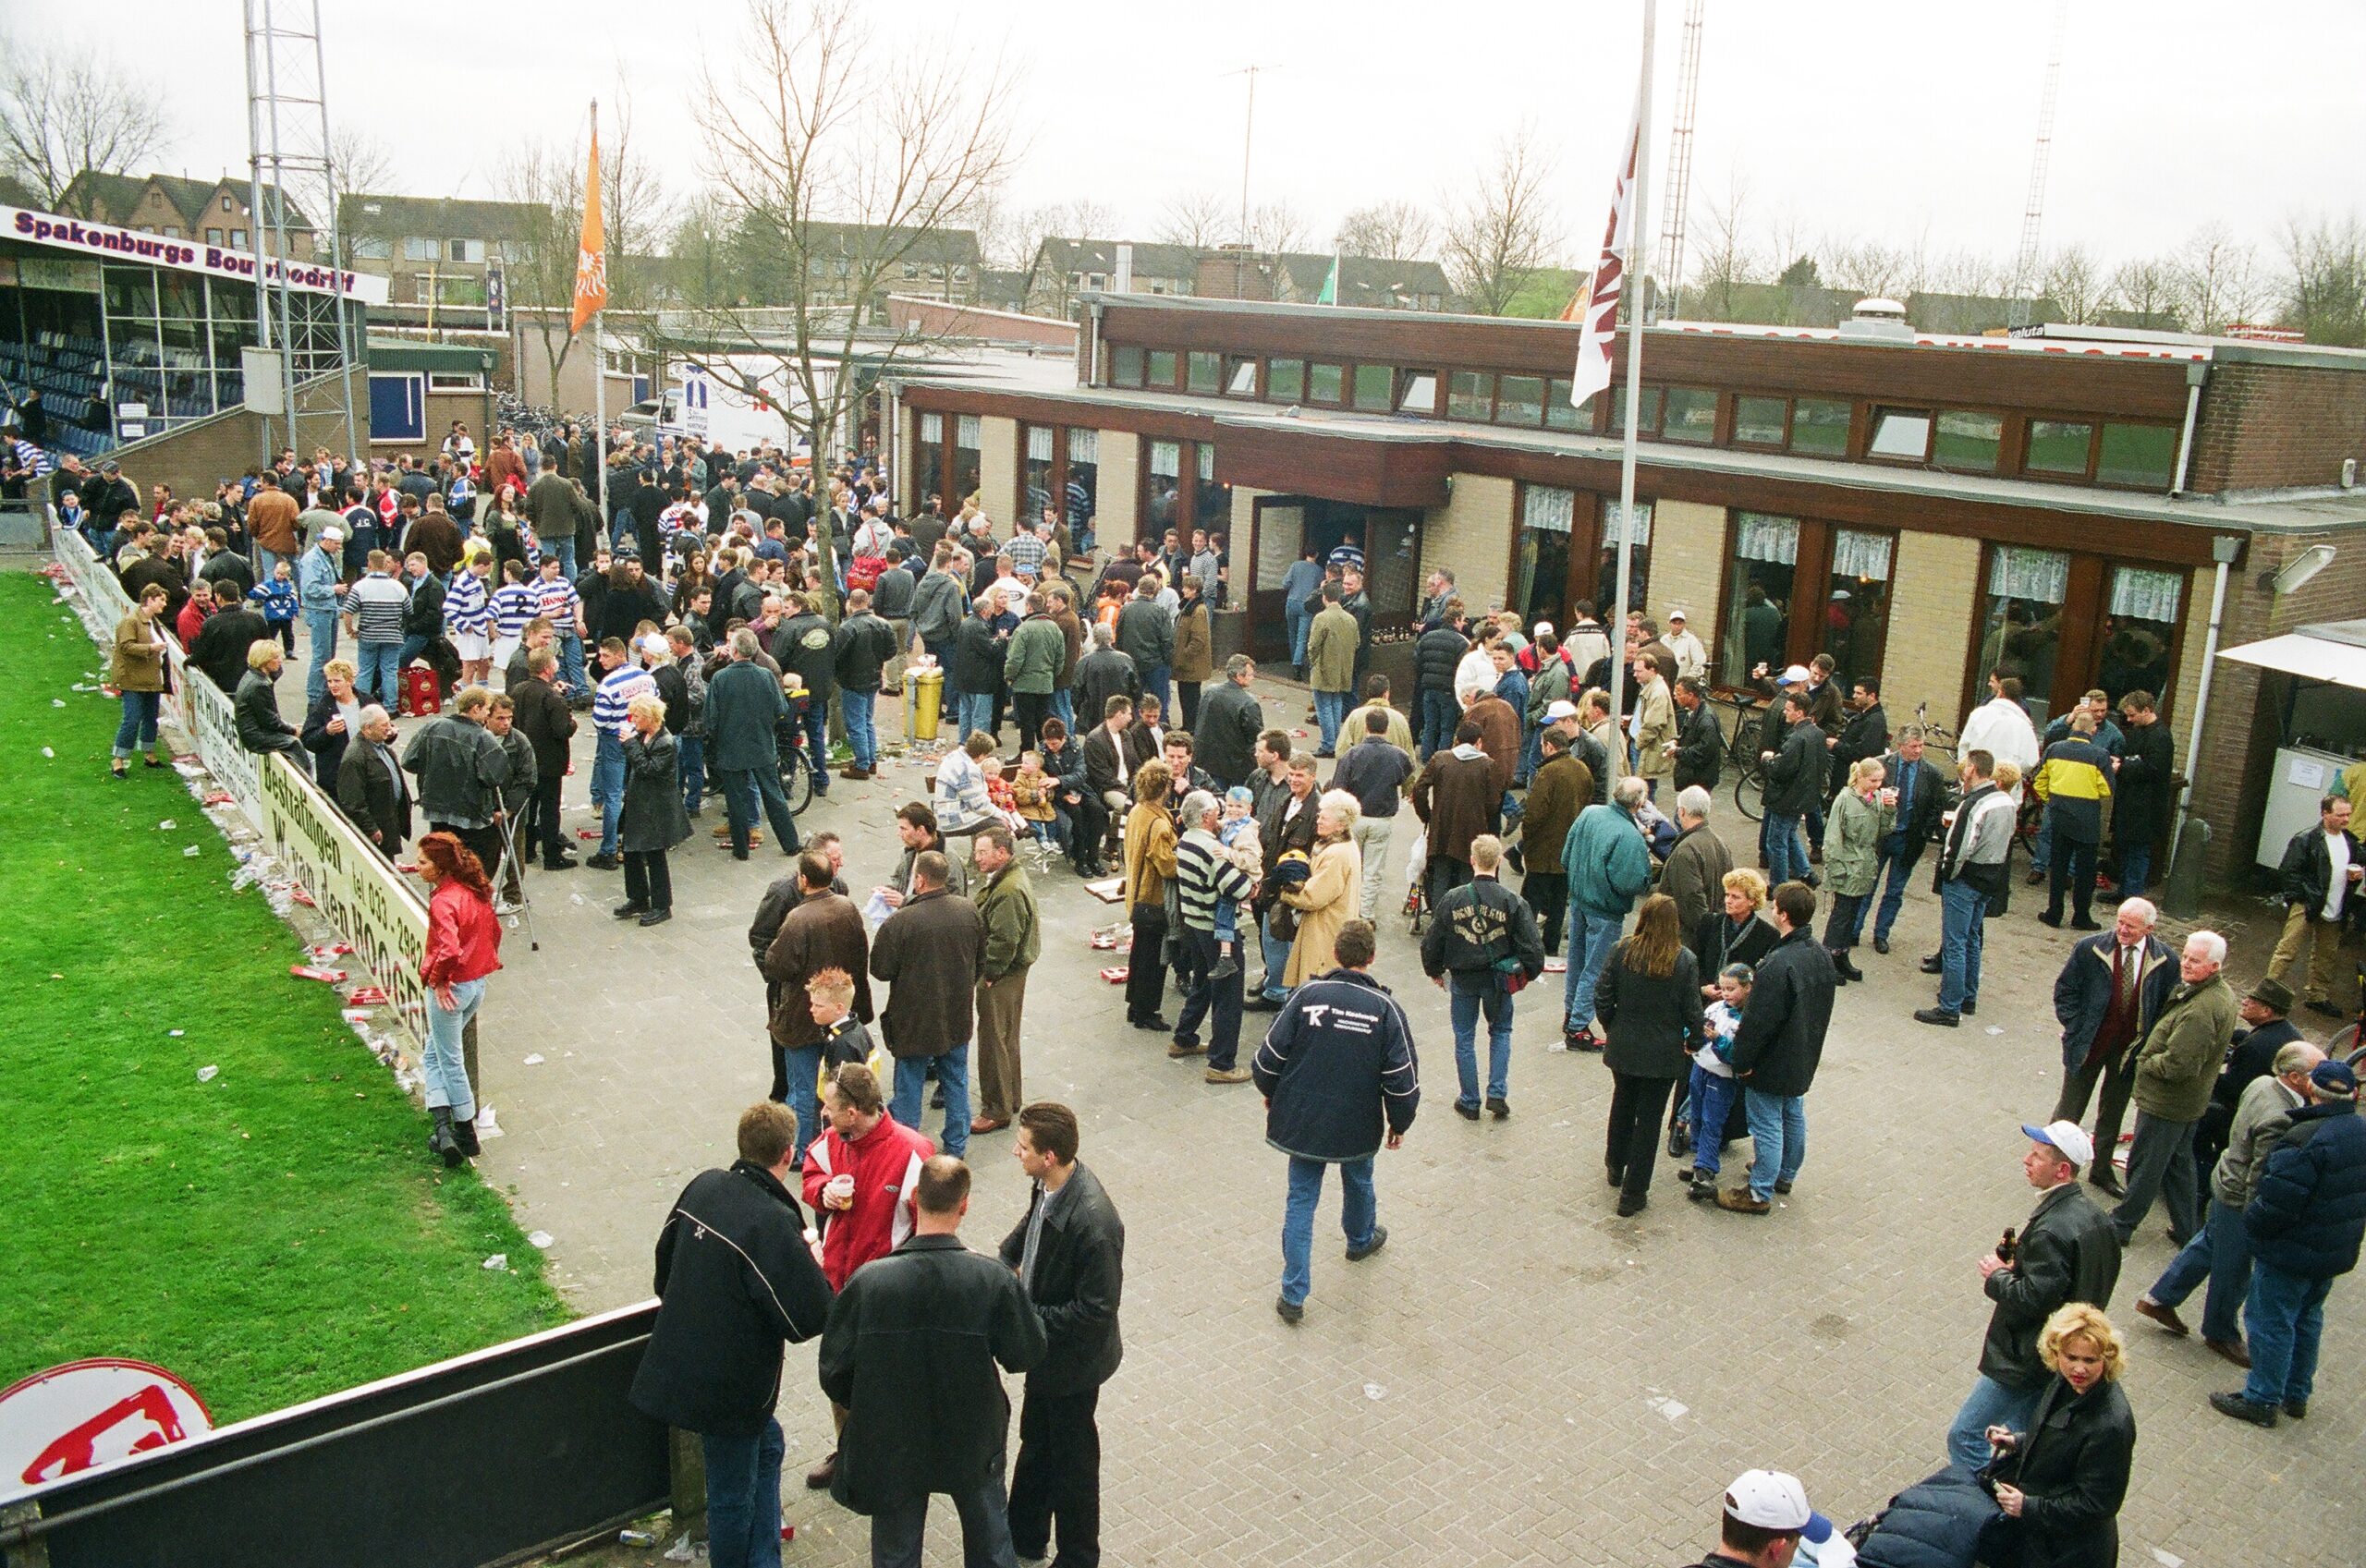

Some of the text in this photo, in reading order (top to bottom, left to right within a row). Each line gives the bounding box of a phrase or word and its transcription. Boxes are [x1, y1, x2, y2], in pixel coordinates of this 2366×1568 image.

[15, 212, 194, 264] Spakenburgs
[2008, 325, 2044, 339] valuta
[515, 594, 528, 614] 2
[264, 754, 342, 875] Bestratingen
[322, 870, 351, 941] den
